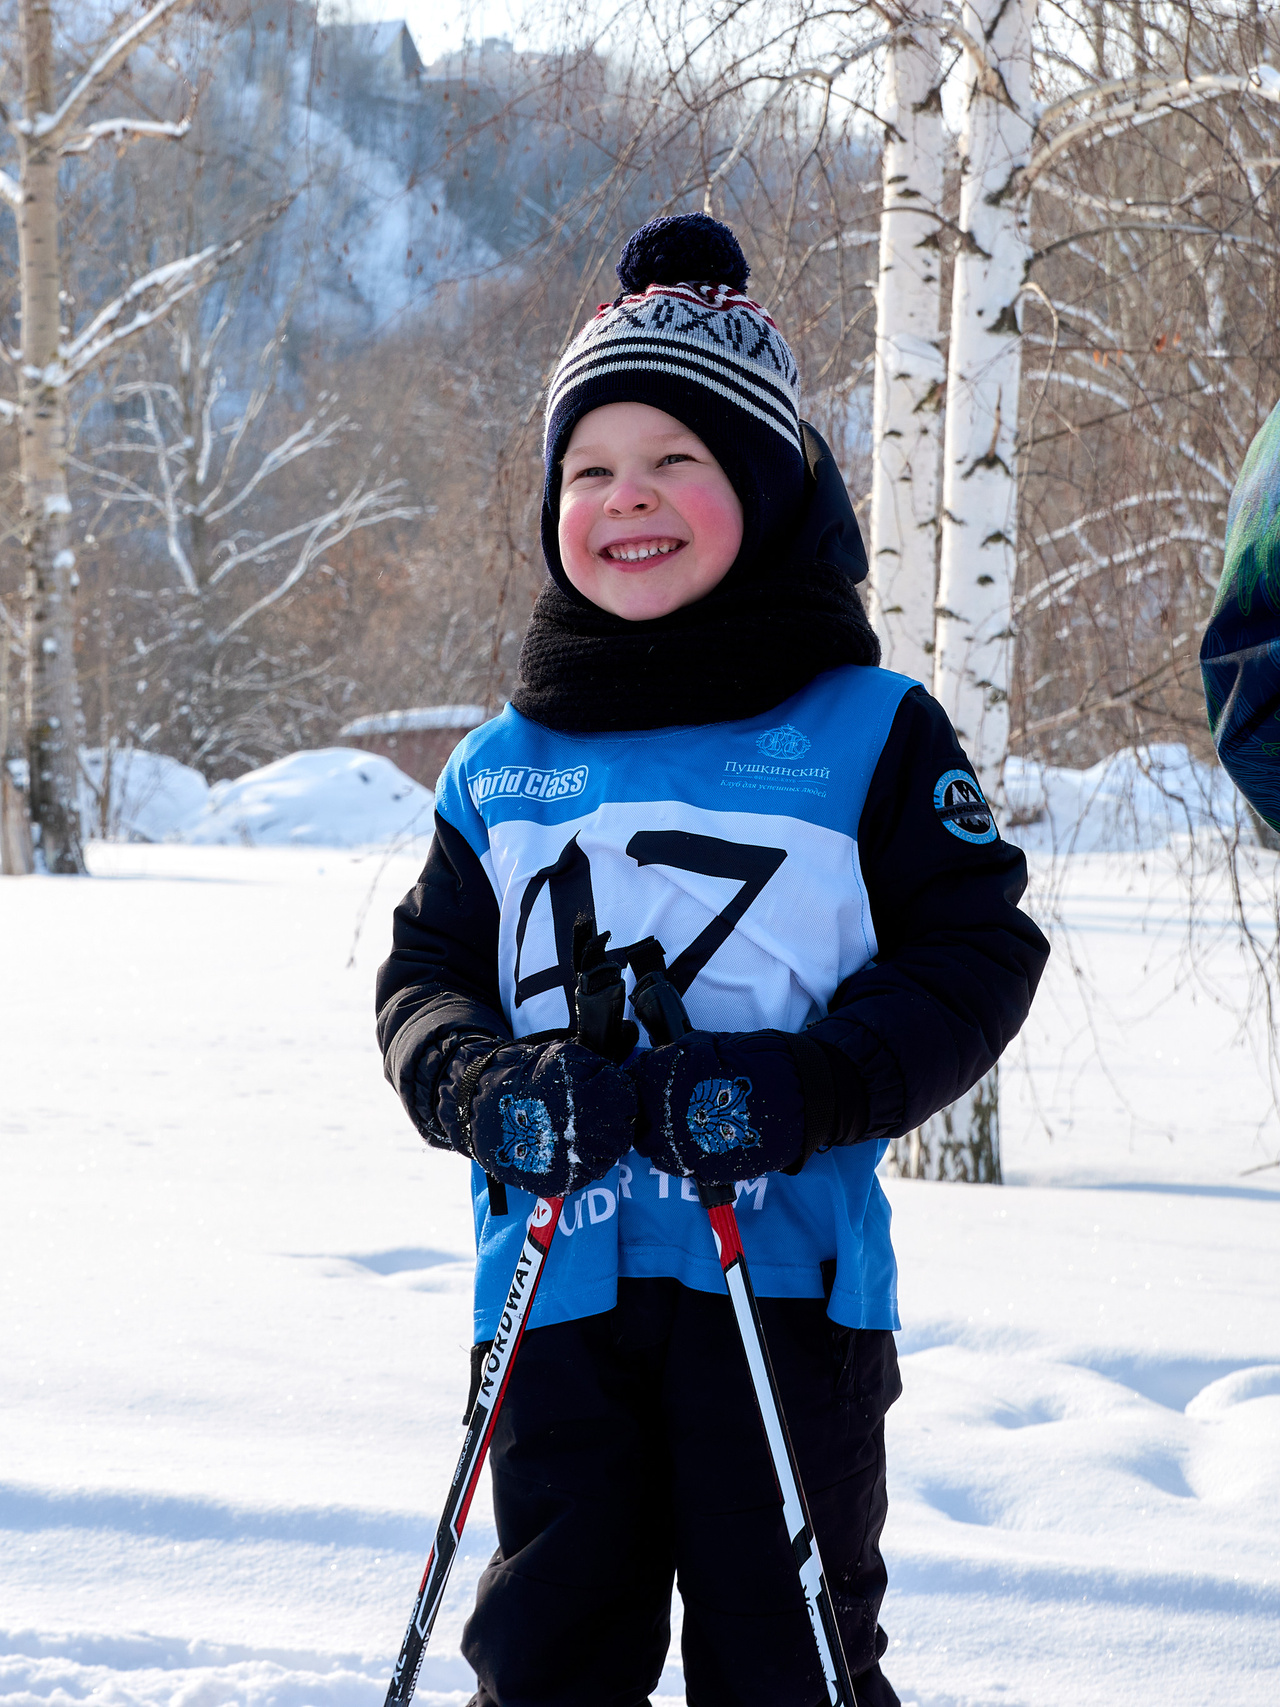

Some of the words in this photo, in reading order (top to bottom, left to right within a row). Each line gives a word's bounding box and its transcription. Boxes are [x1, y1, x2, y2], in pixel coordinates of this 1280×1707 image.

[467, 769, 525, 811] World
[524, 769, 585, 799] Class
[720, 779, 741, 789] Клуб
[742, 780, 757, 789] для
[757, 783, 800, 792] успешных
[800, 786, 827, 798] людей
[724, 761, 831, 780] Пушкинский
[513, 828, 789, 1032] 47
[480, 1248, 533, 1398] NORDWAY
